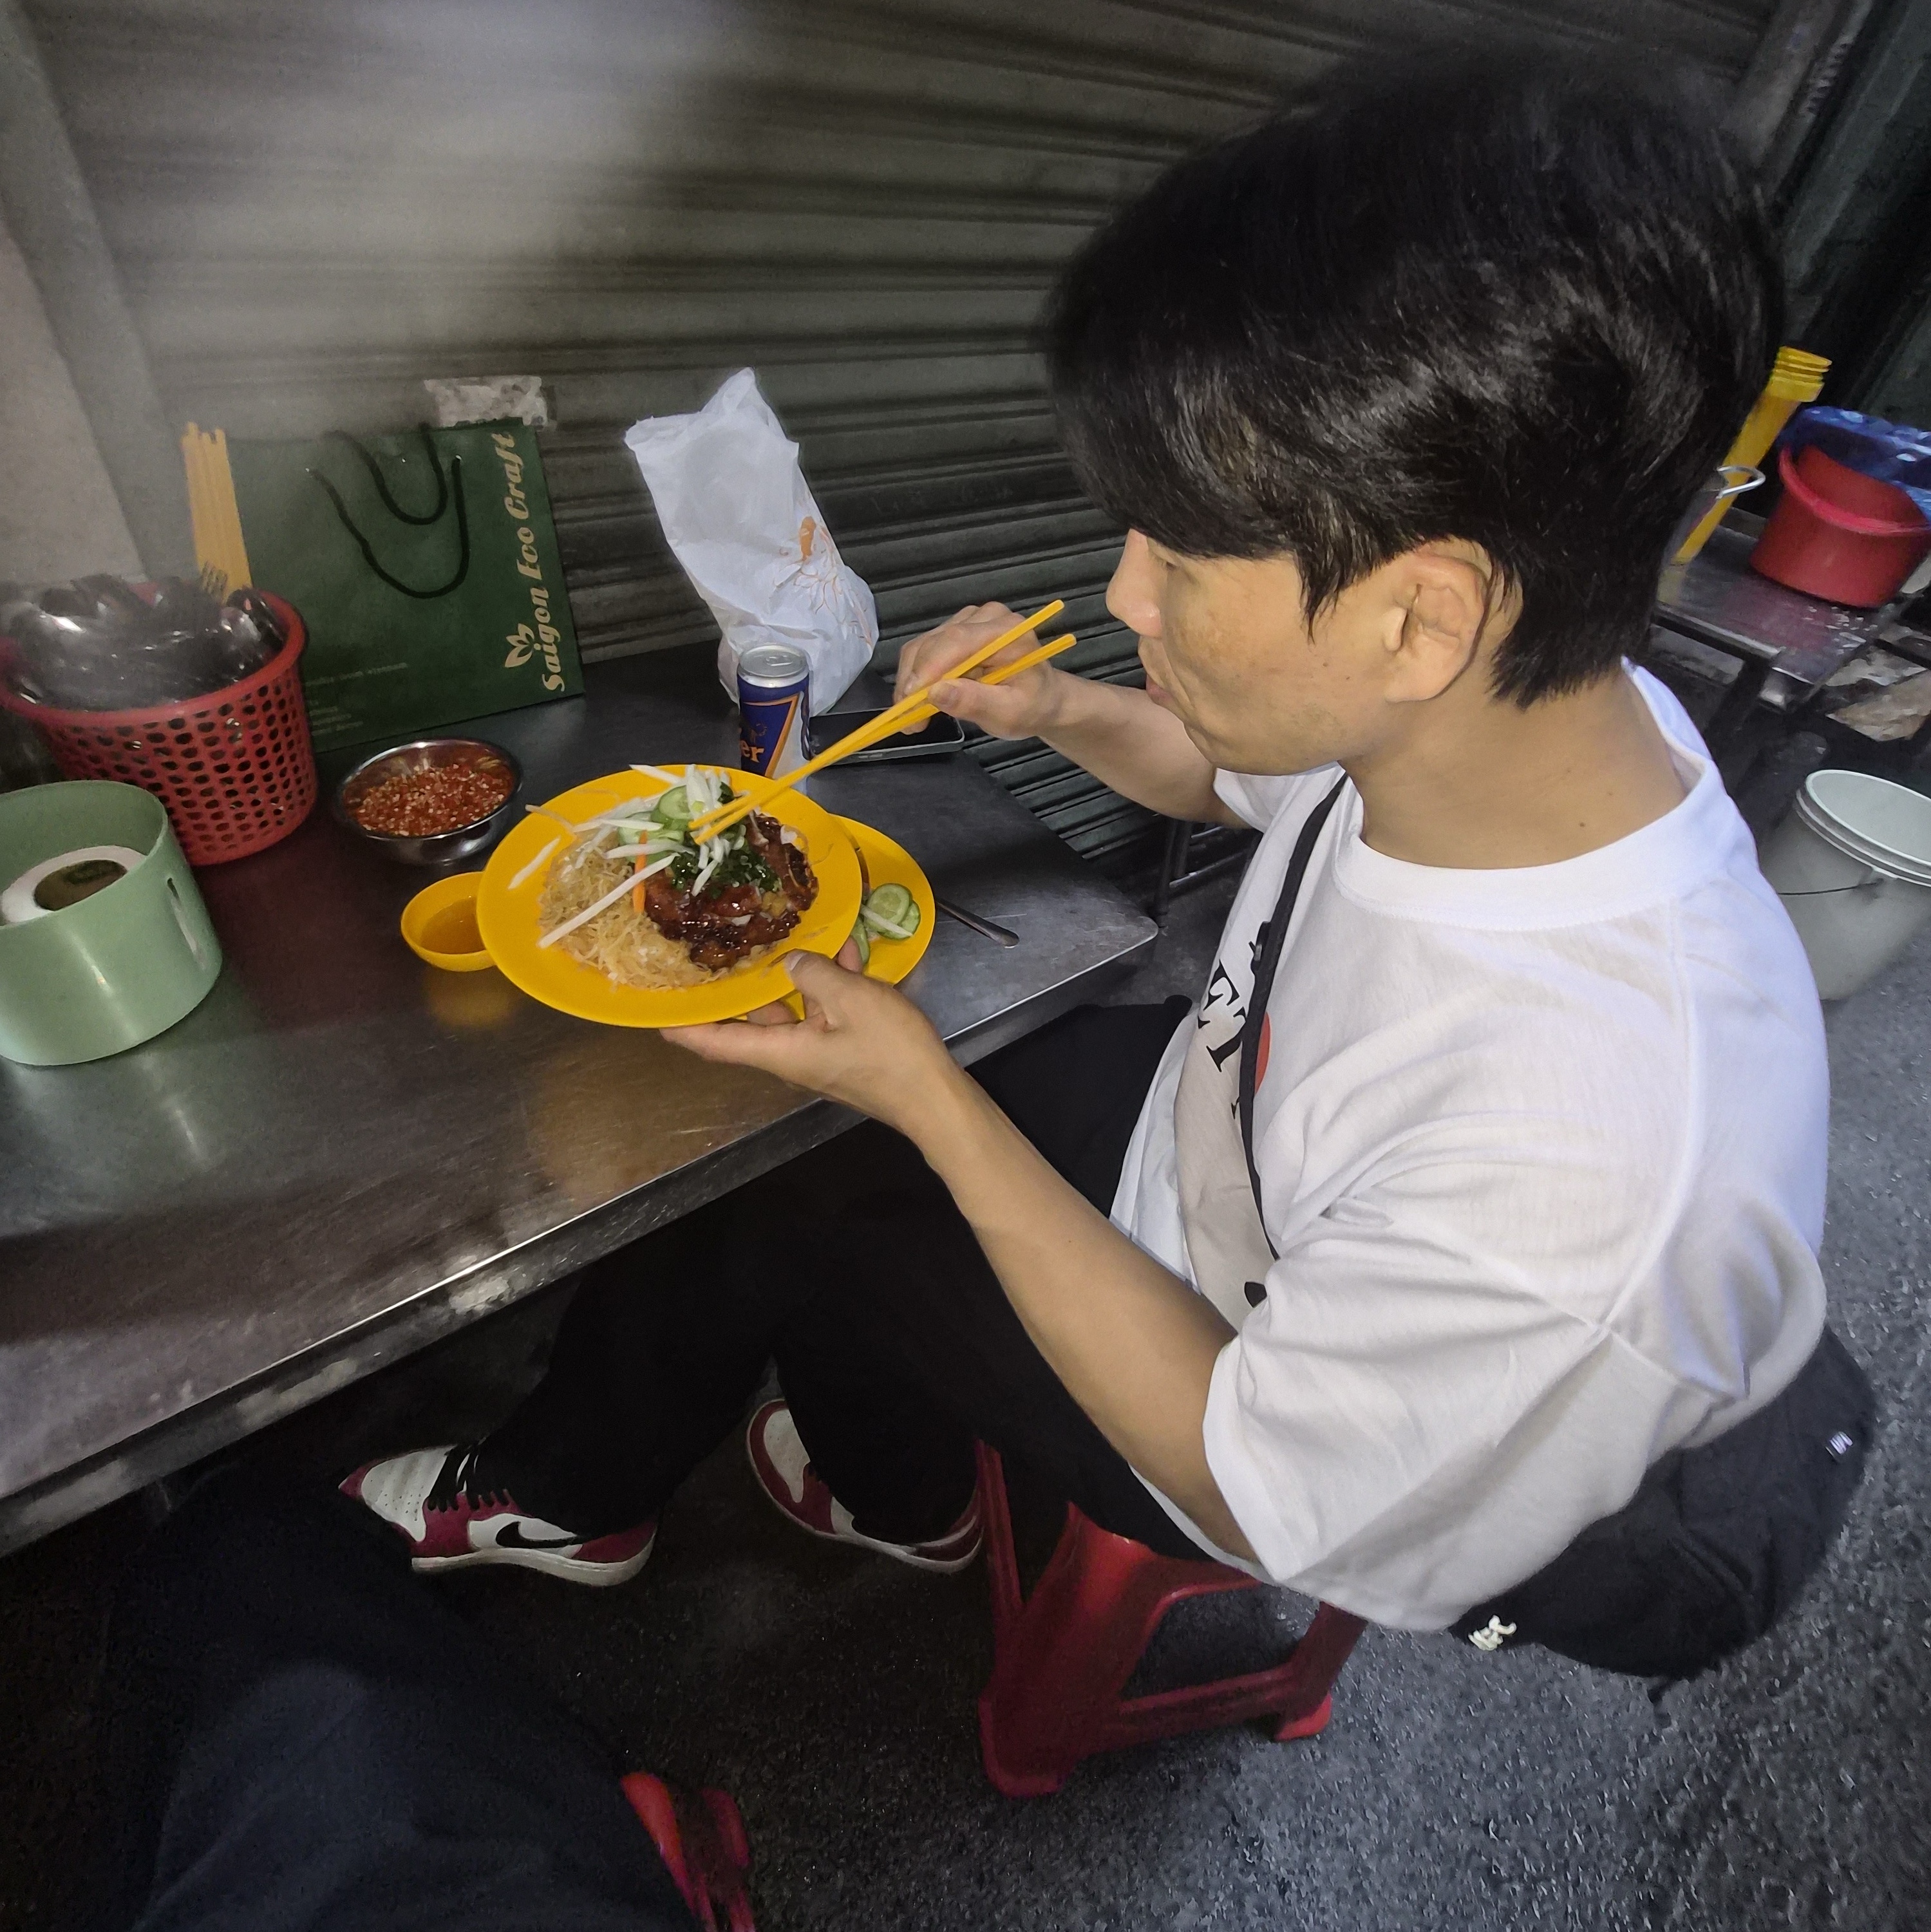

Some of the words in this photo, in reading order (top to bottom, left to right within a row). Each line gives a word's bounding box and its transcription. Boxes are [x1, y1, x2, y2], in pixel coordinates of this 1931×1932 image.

[491, 432, 529, 520] Craft
[516, 526, 542, 580] Eco
[529, 586, 565, 692] Saigon
